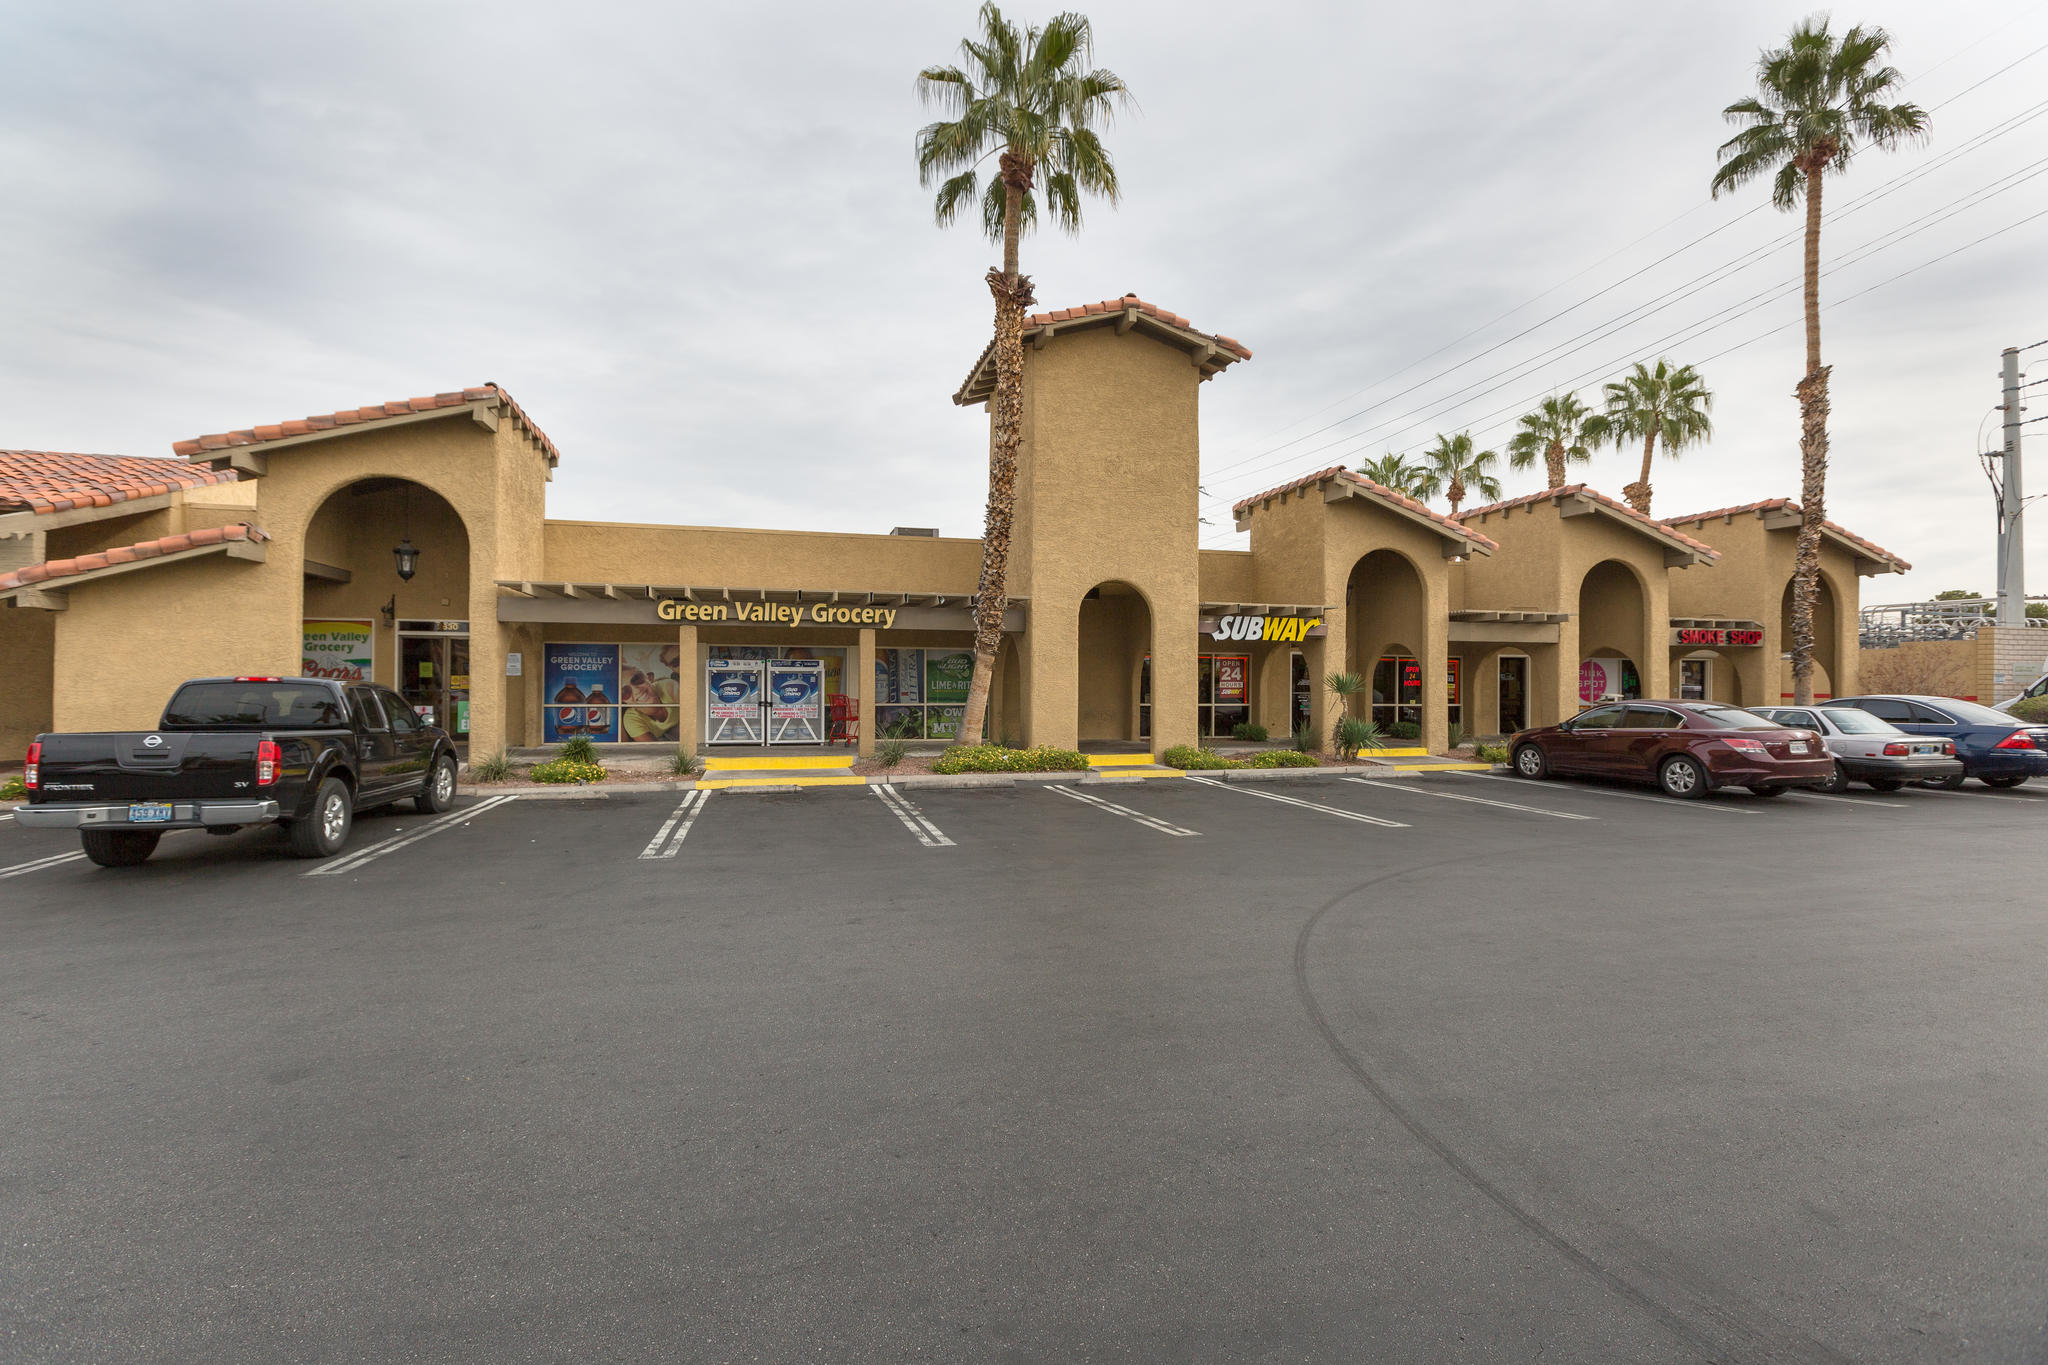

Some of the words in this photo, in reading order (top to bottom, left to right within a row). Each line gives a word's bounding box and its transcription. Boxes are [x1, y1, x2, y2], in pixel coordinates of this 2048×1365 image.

[657, 600, 728, 621] Green
[735, 601, 804, 628] Valley
[811, 603, 897, 629] Grocery
[1211, 615, 1320, 642] SUBWAY
[303, 633, 329, 642] een
[330, 632, 369, 644] Valley
[1681, 629, 1724, 645] SMOKE
[1730, 630, 1762, 645] SHOP
[304, 641, 354, 654] Grocery
[550, 656, 580, 664] GREEN
[581, 656, 613, 664] VALLEY
[560, 663, 604, 671] GROCERY
[1221, 667, 1242, 681] 24
[931, 680, 952, 690] LIME
[957, 680, 971, 690] RIT
[943, 707, 964, 717] OW
[933, 722, 960, 734] MT
